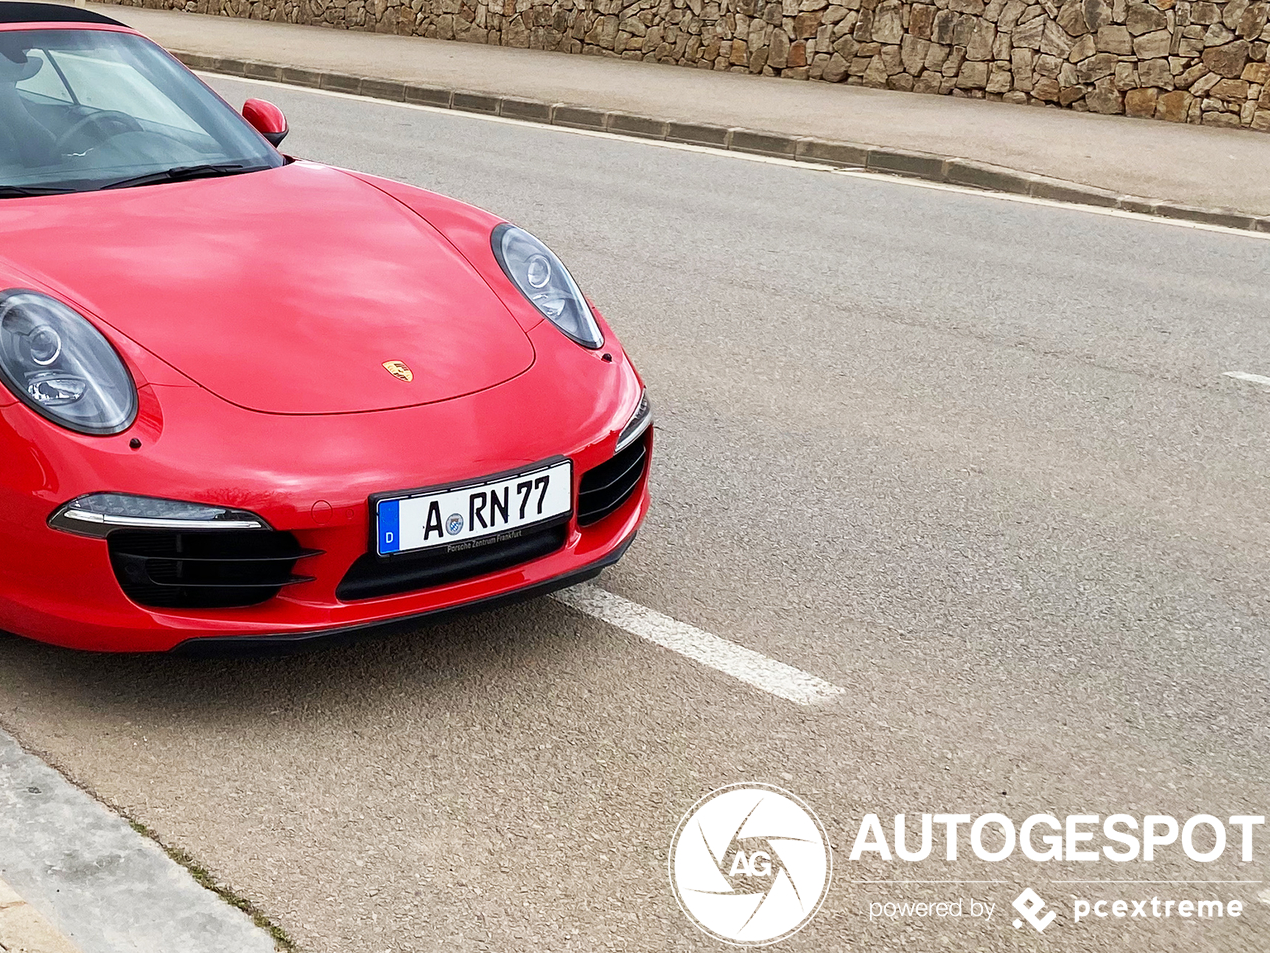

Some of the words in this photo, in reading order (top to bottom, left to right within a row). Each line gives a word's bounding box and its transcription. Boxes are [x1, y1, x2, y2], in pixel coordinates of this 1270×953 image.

[385, 531, 394, 544] D
[423, 500, 444, 541] A
[468, 486, 509, 532] RN
[516, 475, 550, 520] 77
[447, 542, 471, 553] Porsche
[472, 537, 496, 548] Zentrum
[496, 530, 522, 543] Frankfurt
